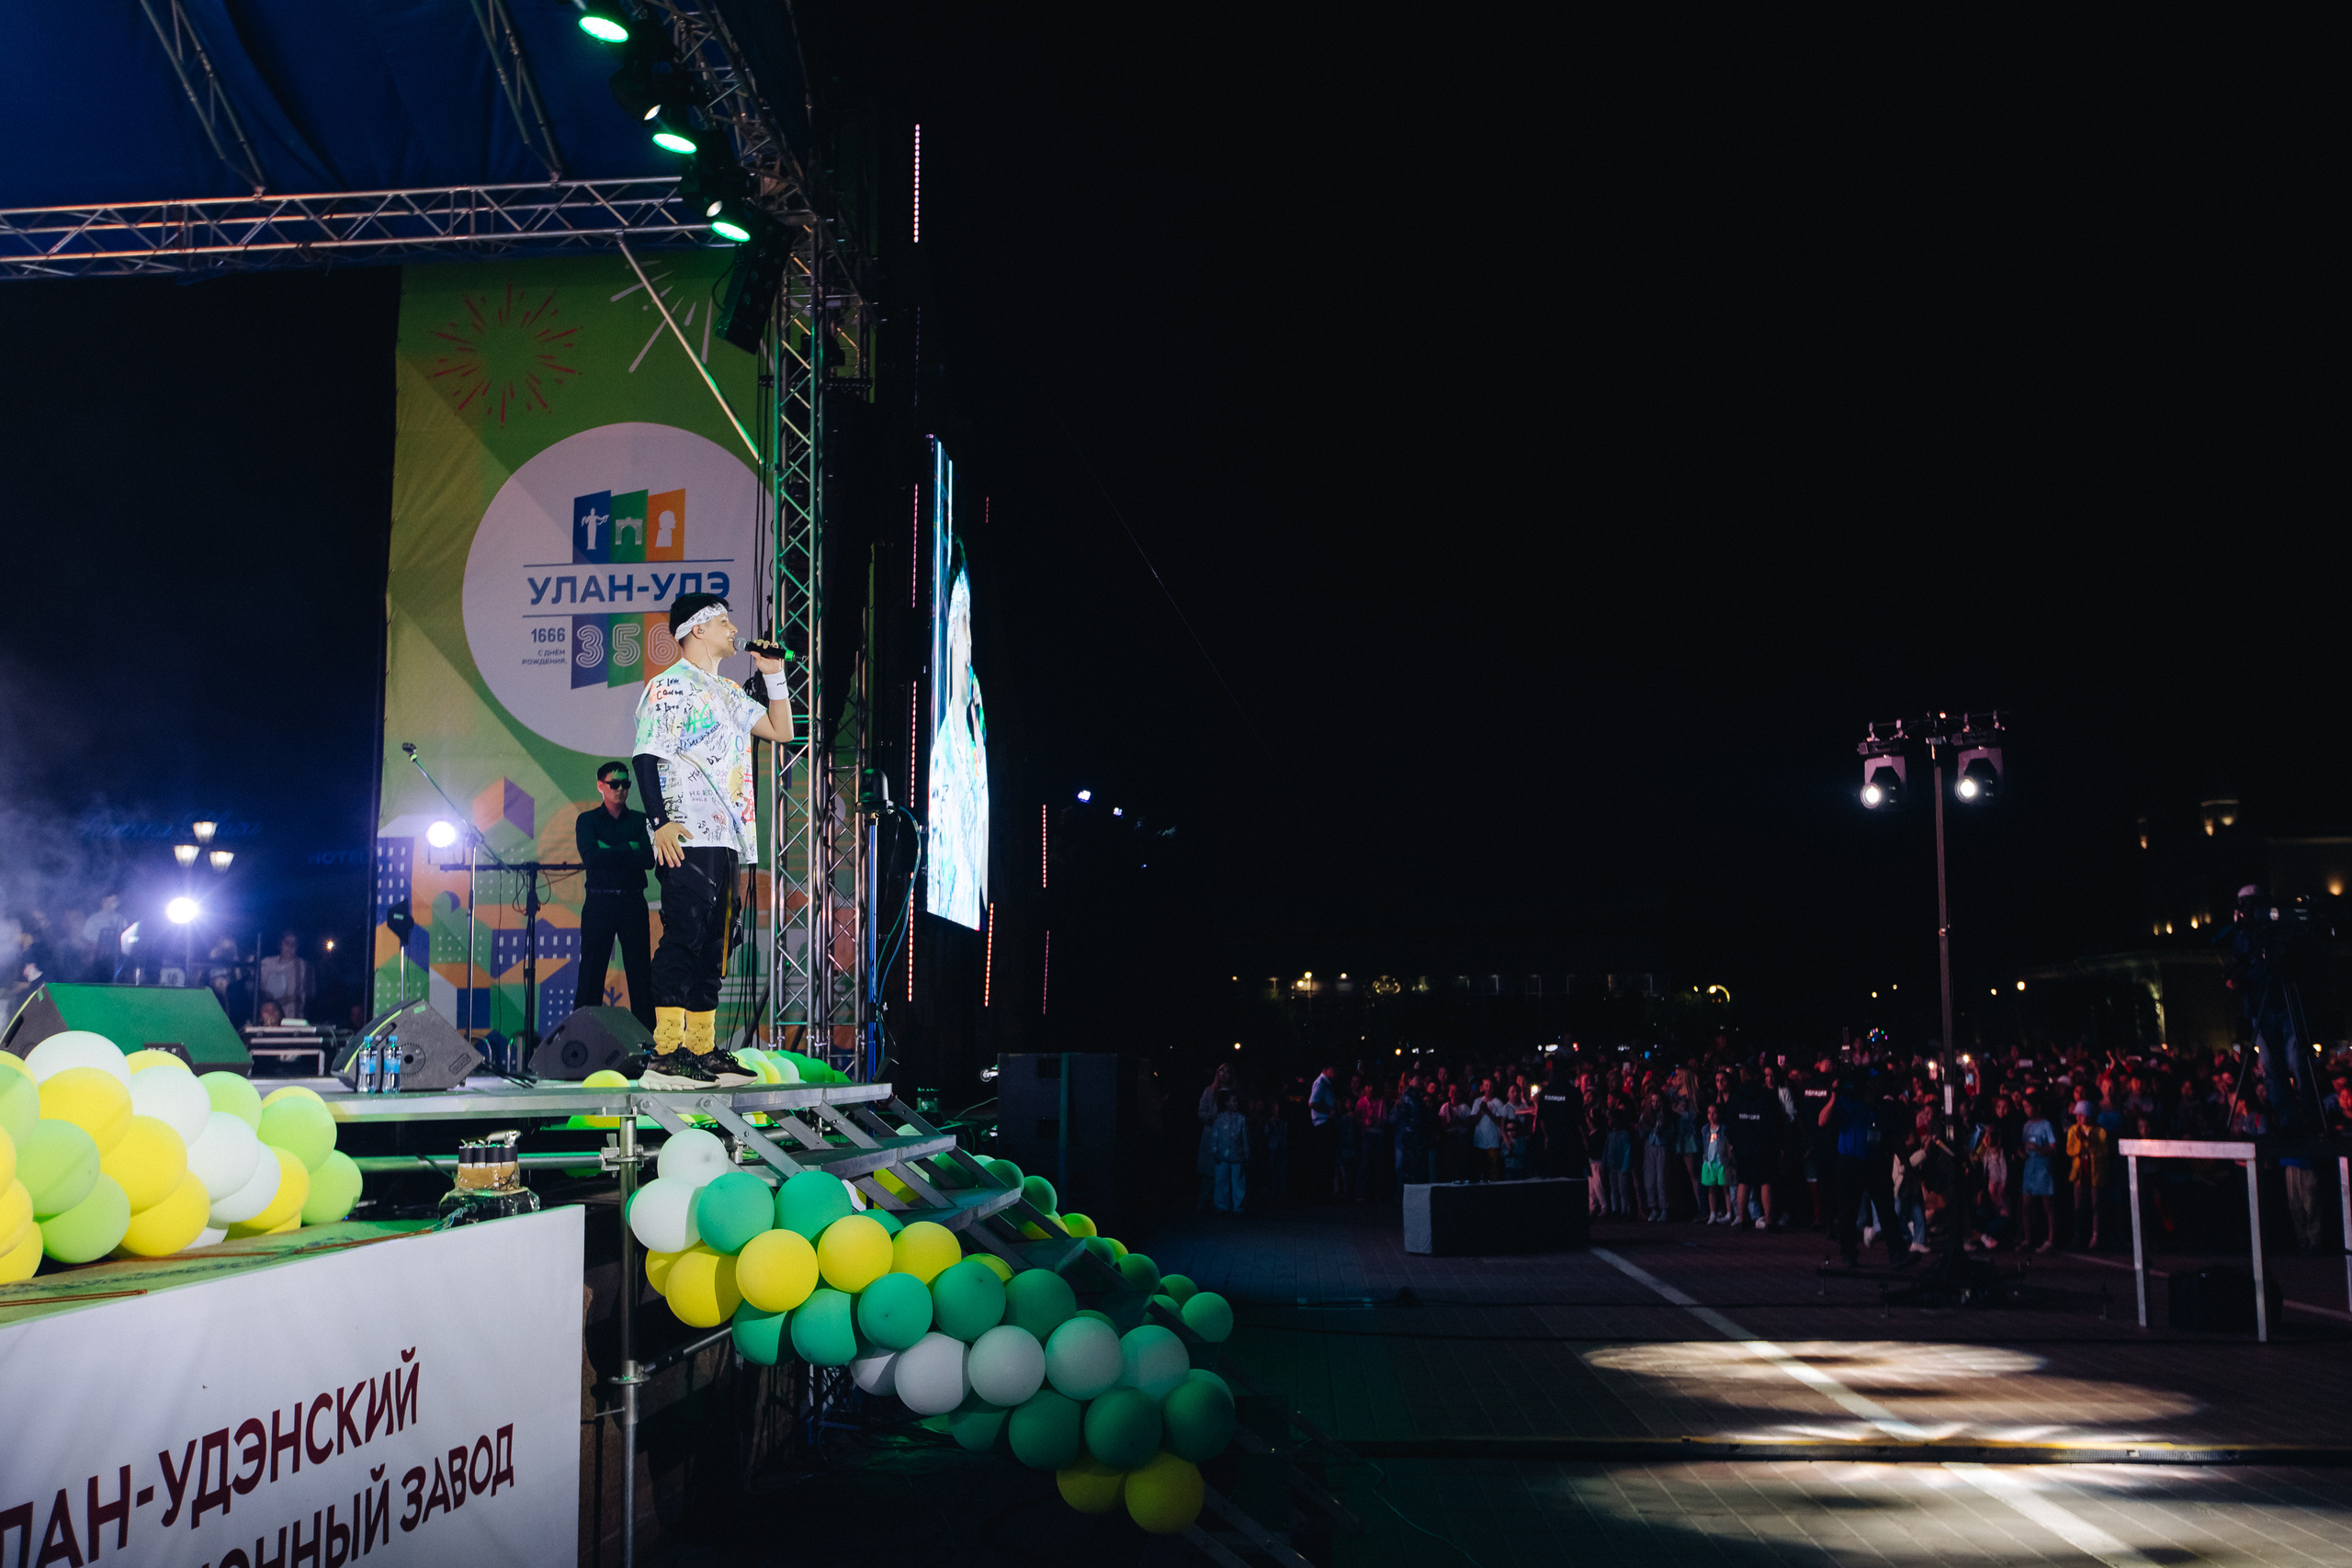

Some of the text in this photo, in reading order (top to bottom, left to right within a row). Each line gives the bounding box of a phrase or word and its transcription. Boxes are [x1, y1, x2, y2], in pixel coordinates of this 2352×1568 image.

[526, 571, 730, 605] УЛАН-УДЭ
[531, 627, 566, 643] 1666
[400, 1423, 514, 1533] ЗАВОД
